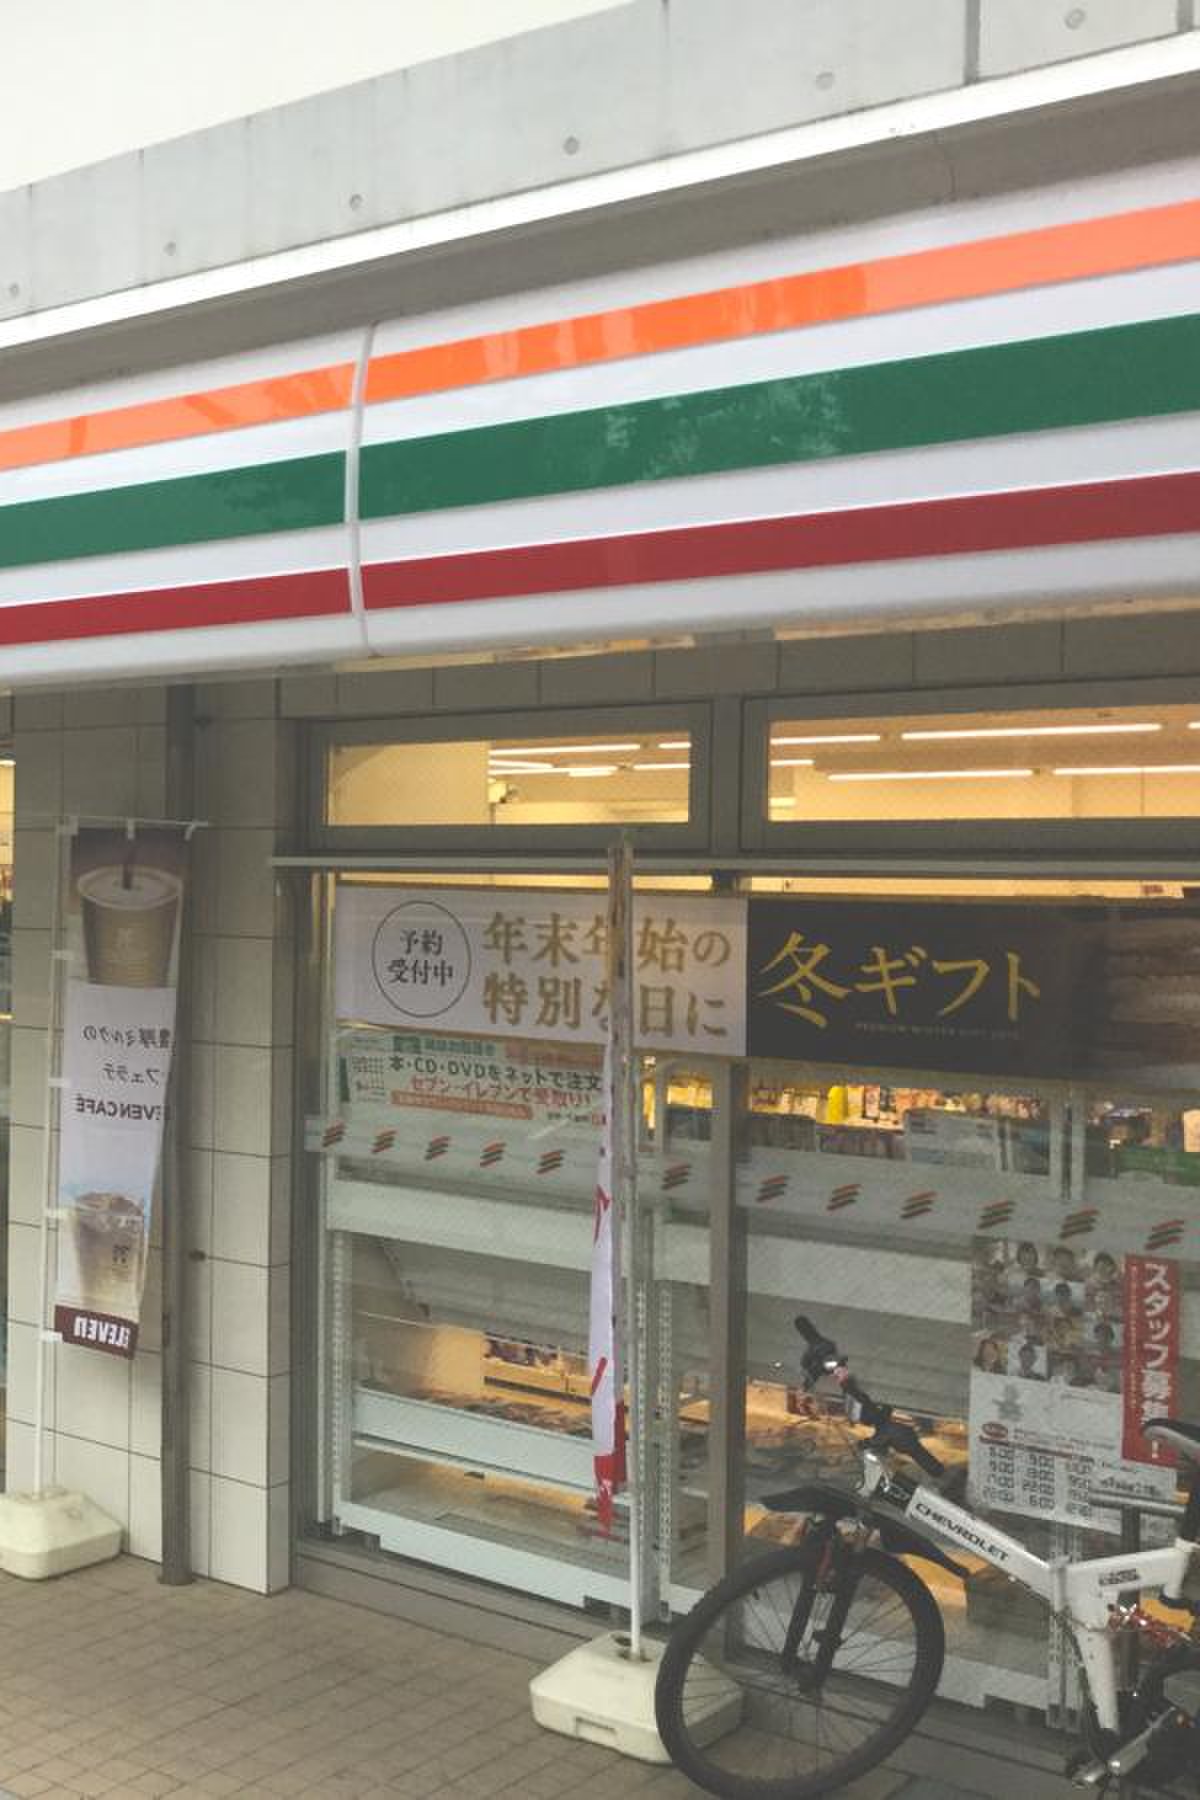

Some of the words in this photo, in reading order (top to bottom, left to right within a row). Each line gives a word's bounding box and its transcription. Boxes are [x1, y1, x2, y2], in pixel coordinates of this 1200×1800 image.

[400, 929, 443, 956] 予約
[388, 958, 454, 988] 受付中
[757, 930, 1040, 1028] 冬ギフト
[914, 1503, 1008, 1561] CHEVROLET
